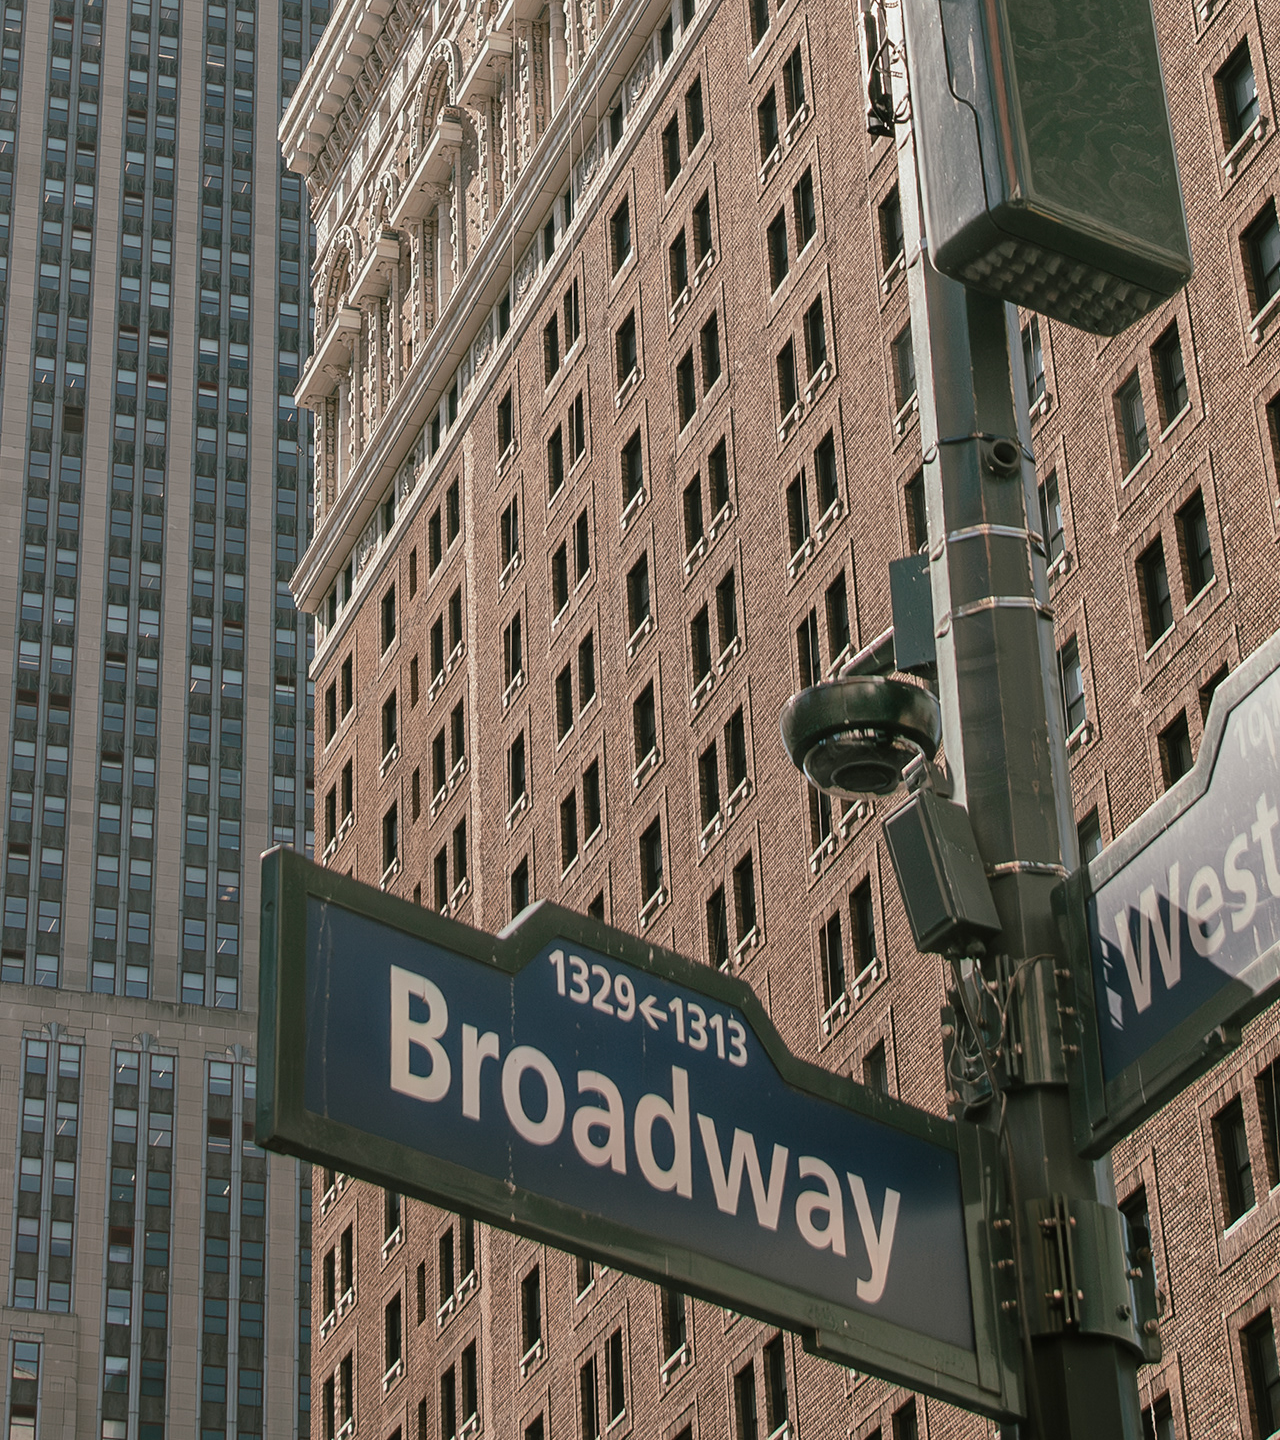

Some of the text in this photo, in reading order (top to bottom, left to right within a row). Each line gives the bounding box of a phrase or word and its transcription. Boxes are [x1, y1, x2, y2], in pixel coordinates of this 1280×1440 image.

[548, 949, 749, 1068] 1329 1313
[389, 964, 901, 1303] Broadway
